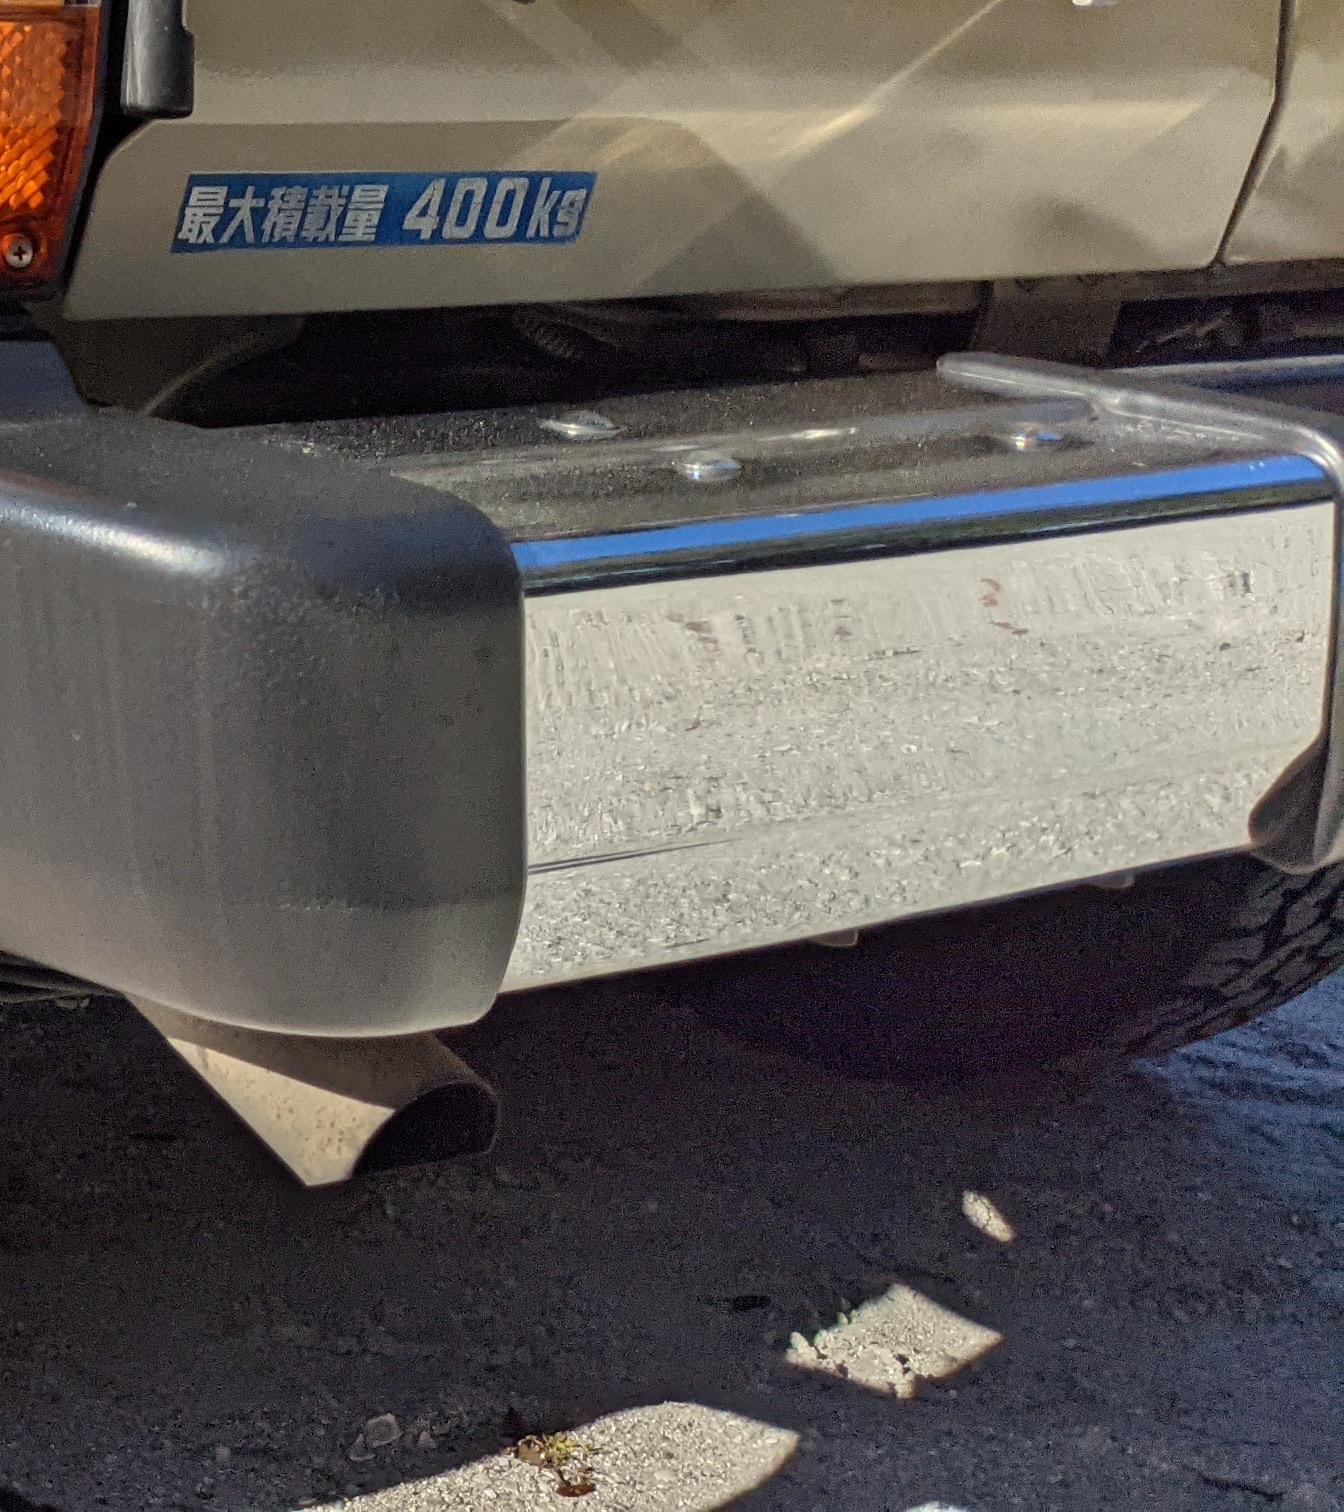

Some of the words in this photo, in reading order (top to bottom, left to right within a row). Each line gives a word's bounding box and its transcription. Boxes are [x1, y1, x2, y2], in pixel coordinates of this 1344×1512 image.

[177, 183, 390, 245] 最大積載量
